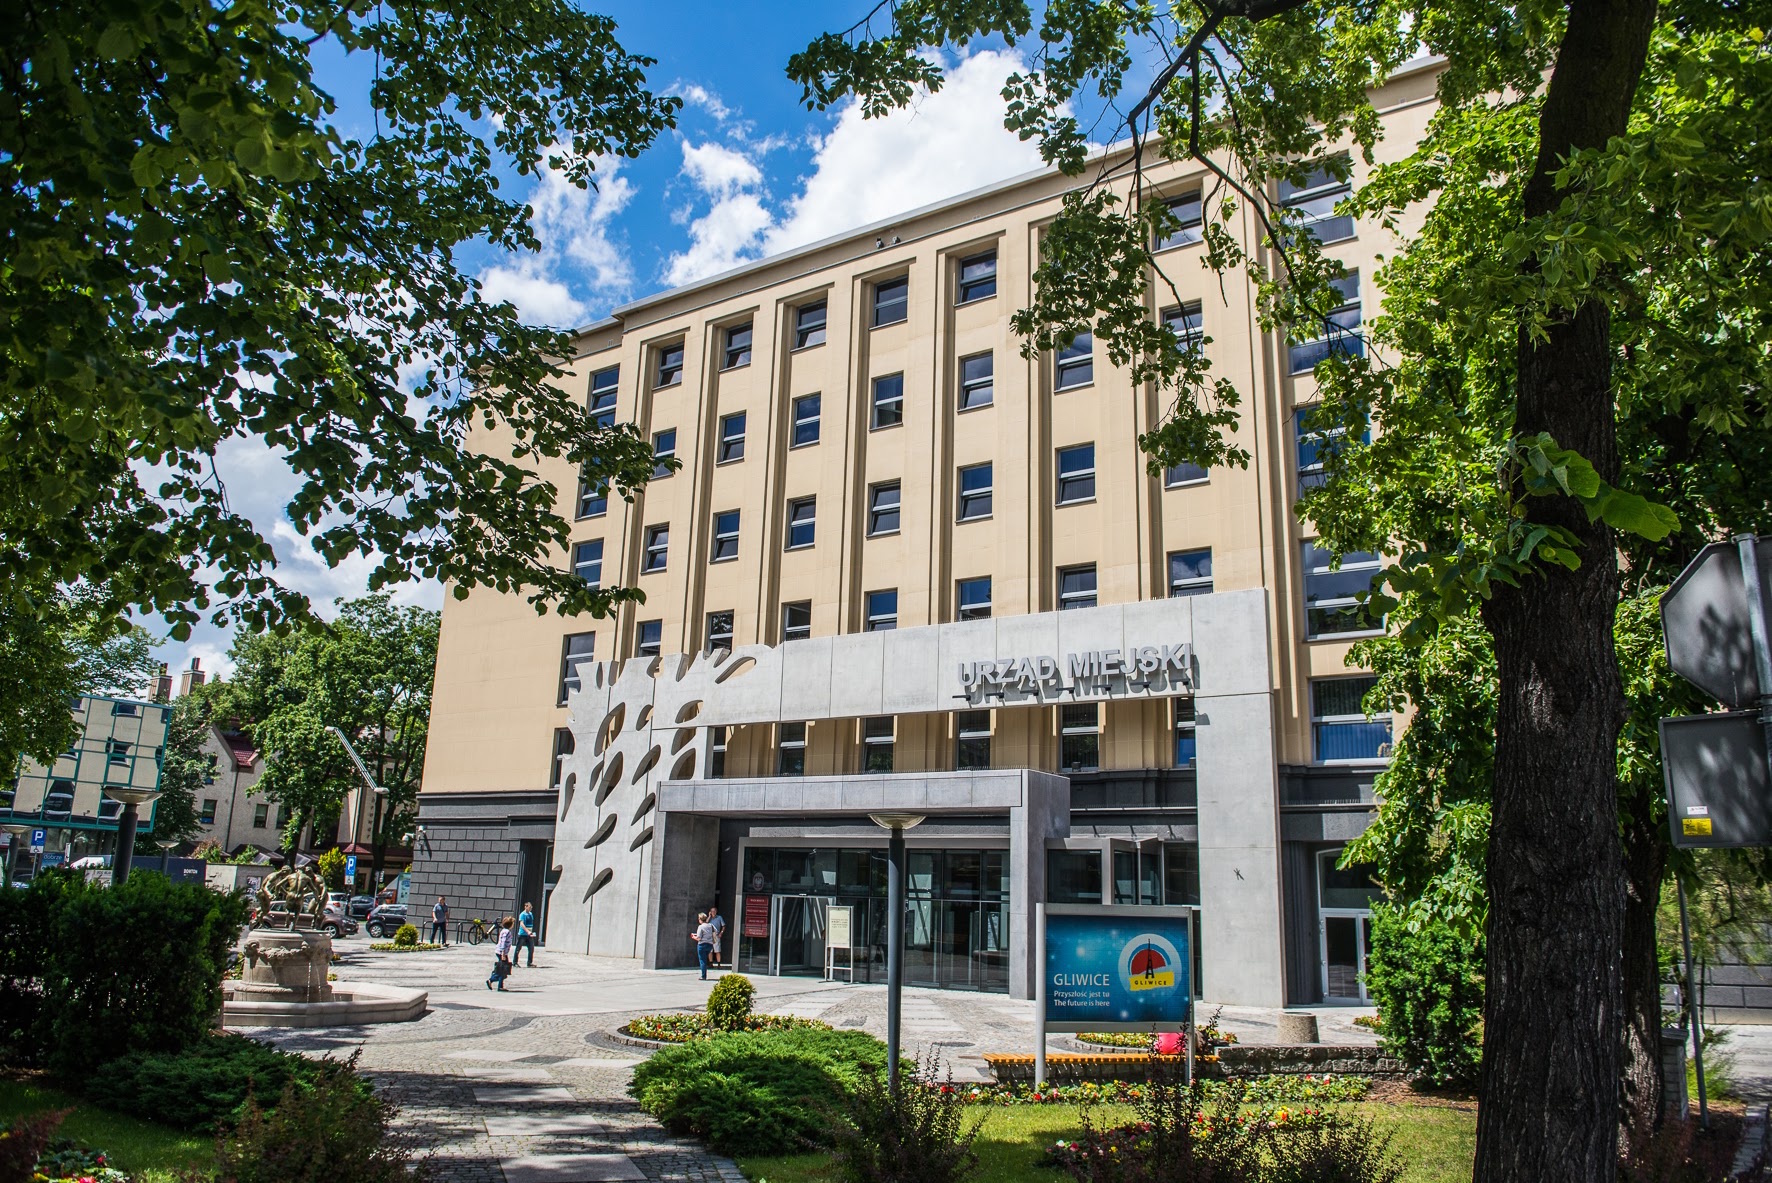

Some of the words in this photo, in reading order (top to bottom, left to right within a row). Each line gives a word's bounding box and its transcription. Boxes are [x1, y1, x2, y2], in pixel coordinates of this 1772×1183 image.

[957, 655, 1057, 687] URZĄD
[1067, 643, 1191, 679] MIEJSKI
[34, 830, 44, 841] P
[347, 858, 354, 870] P
[1053, 973, 1110, 986] GLIWICE
[1089, 990, 1101, 998] jest
[1054, 999, 1067, 1007] The
[1067, 999, 1088, 1007] future
[1088, 999, 1094, 1007] is
[1095, 999, 1110, 1007] here
